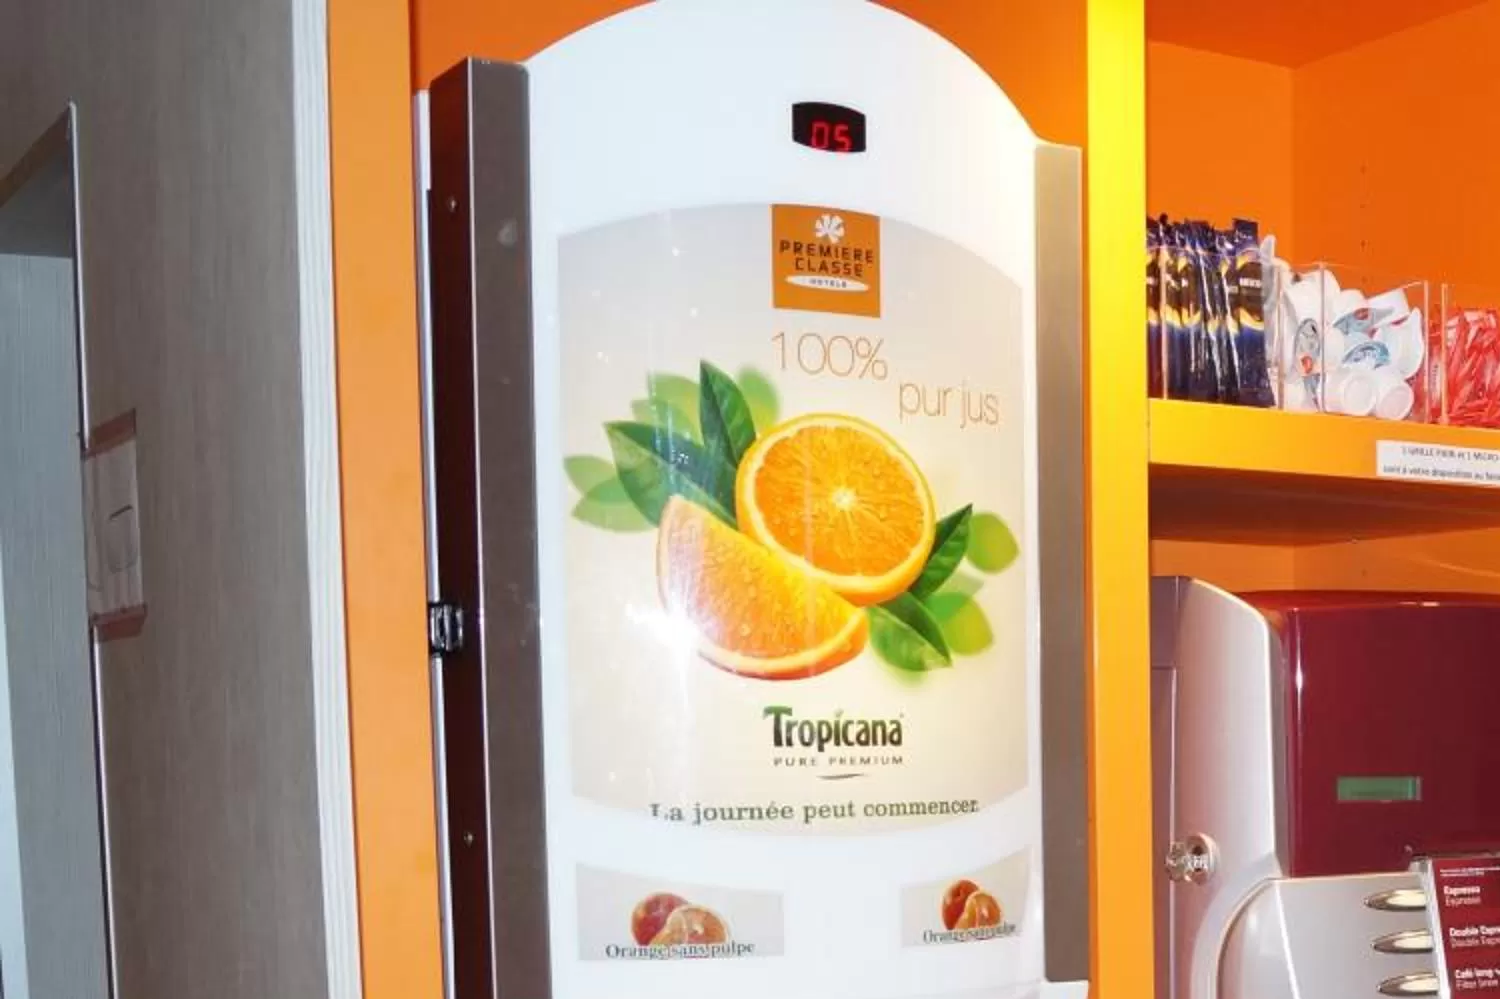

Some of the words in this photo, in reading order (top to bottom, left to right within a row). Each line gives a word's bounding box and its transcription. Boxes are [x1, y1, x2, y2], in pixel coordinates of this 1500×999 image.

[810, 121, 854, 152] 05
[779, 239, 874, 264] PREMIERE
[795, 256, 864, 278] CLASSE
[771, 331, 889, 381] 100%
[899, 382, 953, 424] pur
[959, 378, 1000, 430] jus
[762, 705, 903, 753] Tropicana
[773, 756, 817, 767] PURE
[828, 755, 904, 767] PREMIUM
[692, 800, 794, 825] journée
[803, 800, 856, 824] peut
